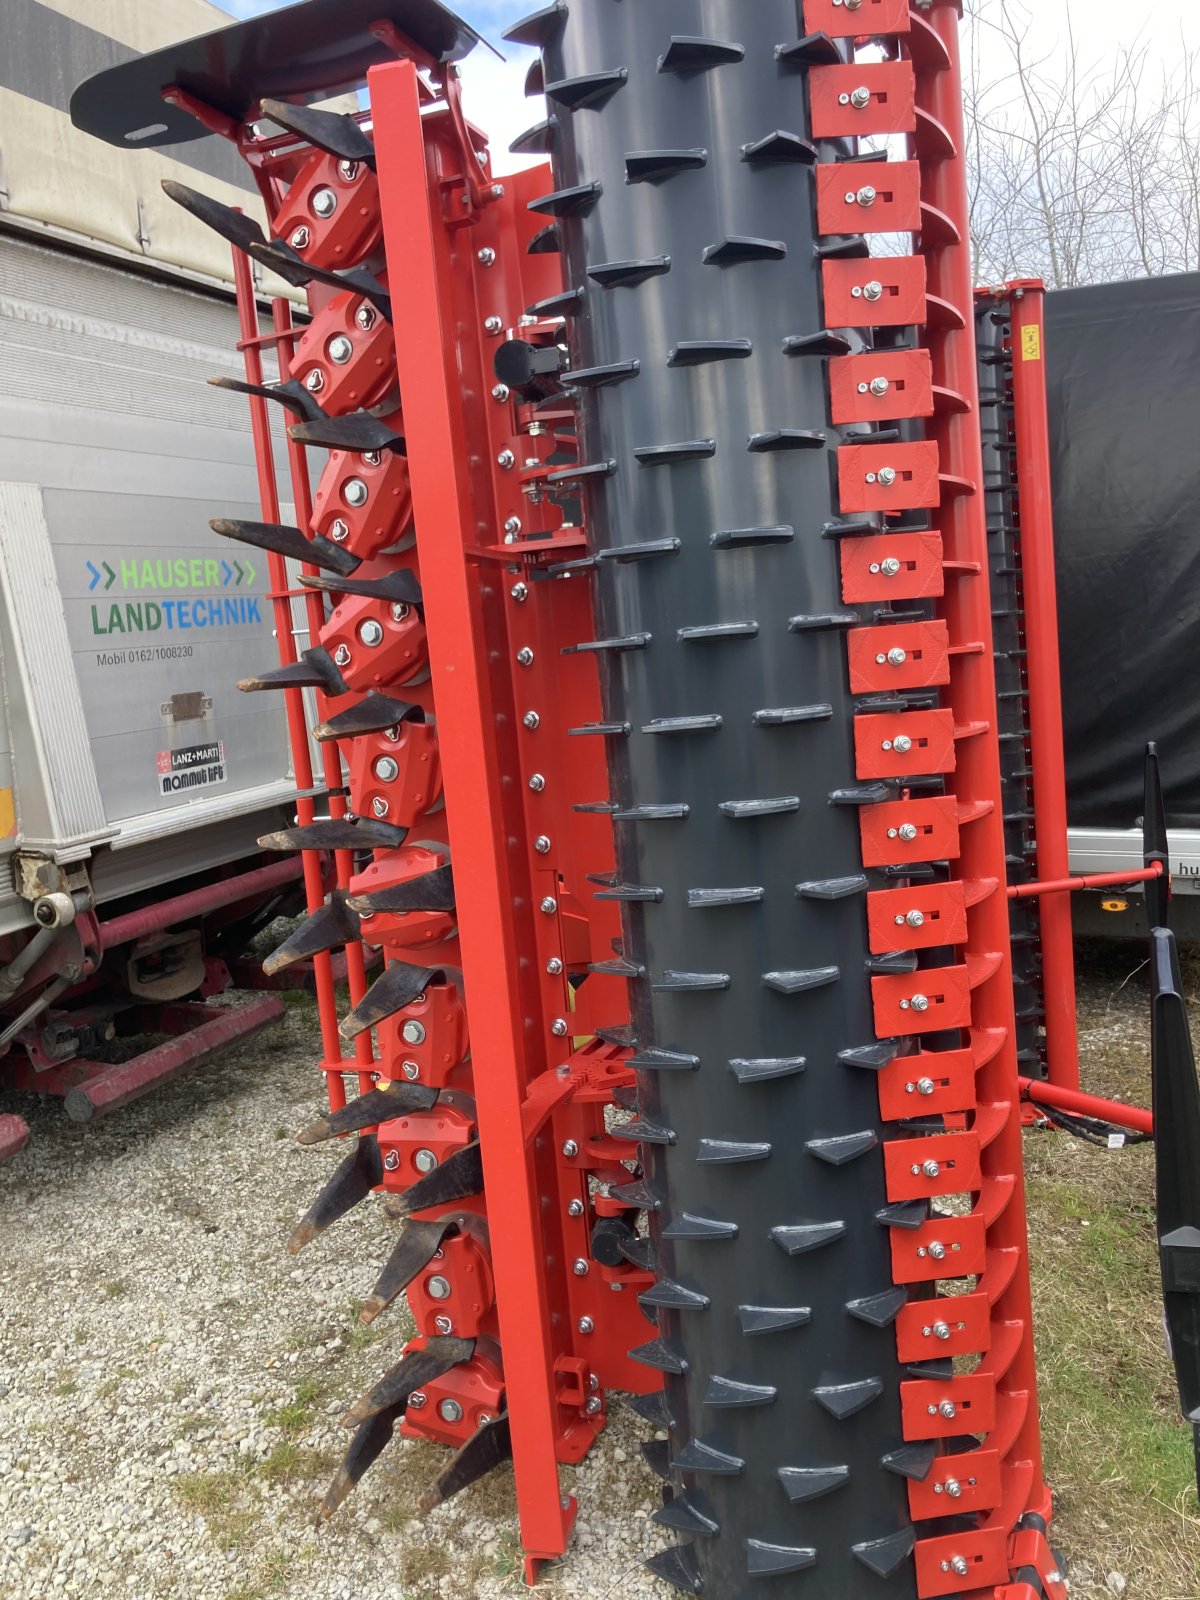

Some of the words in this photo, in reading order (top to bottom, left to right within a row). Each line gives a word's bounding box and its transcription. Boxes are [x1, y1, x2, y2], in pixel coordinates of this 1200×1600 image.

[119, 558, 220, 590] HAUSER
[91, 597, 262, 635] LANDTECHNIK
[96, 651, 126, 667] Mobil
[128, 645, 193, 663] 0162/1008230
